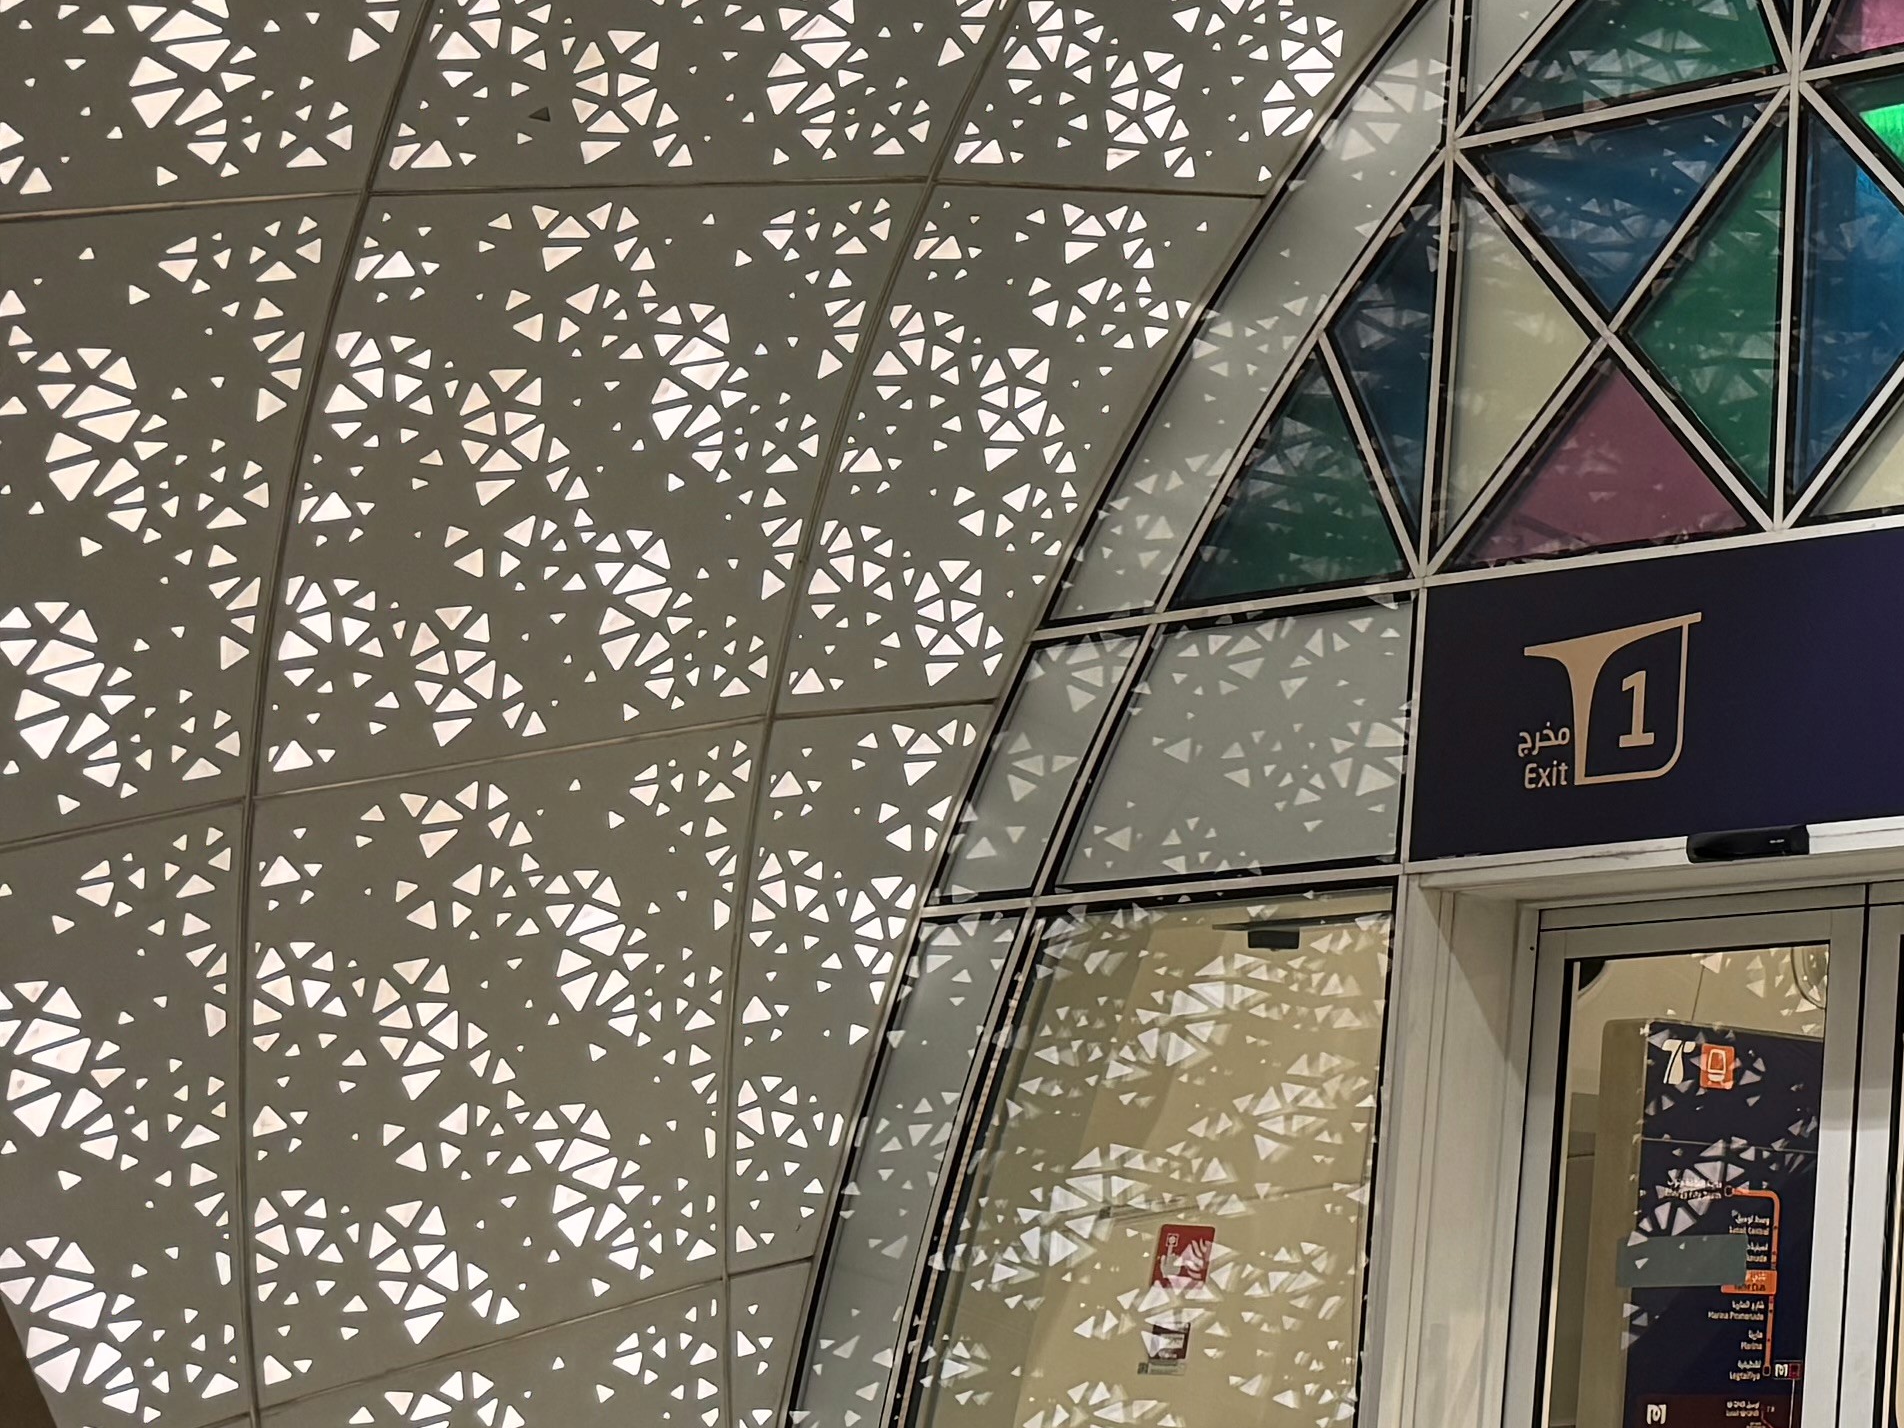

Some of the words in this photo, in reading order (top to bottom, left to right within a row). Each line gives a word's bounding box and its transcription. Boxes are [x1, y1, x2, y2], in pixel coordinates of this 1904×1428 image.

[1619, 670, 1655, 748] 1
[1517, 722, 1571, 758] مخرج
[1524, 760, 1569, 789] Exit
